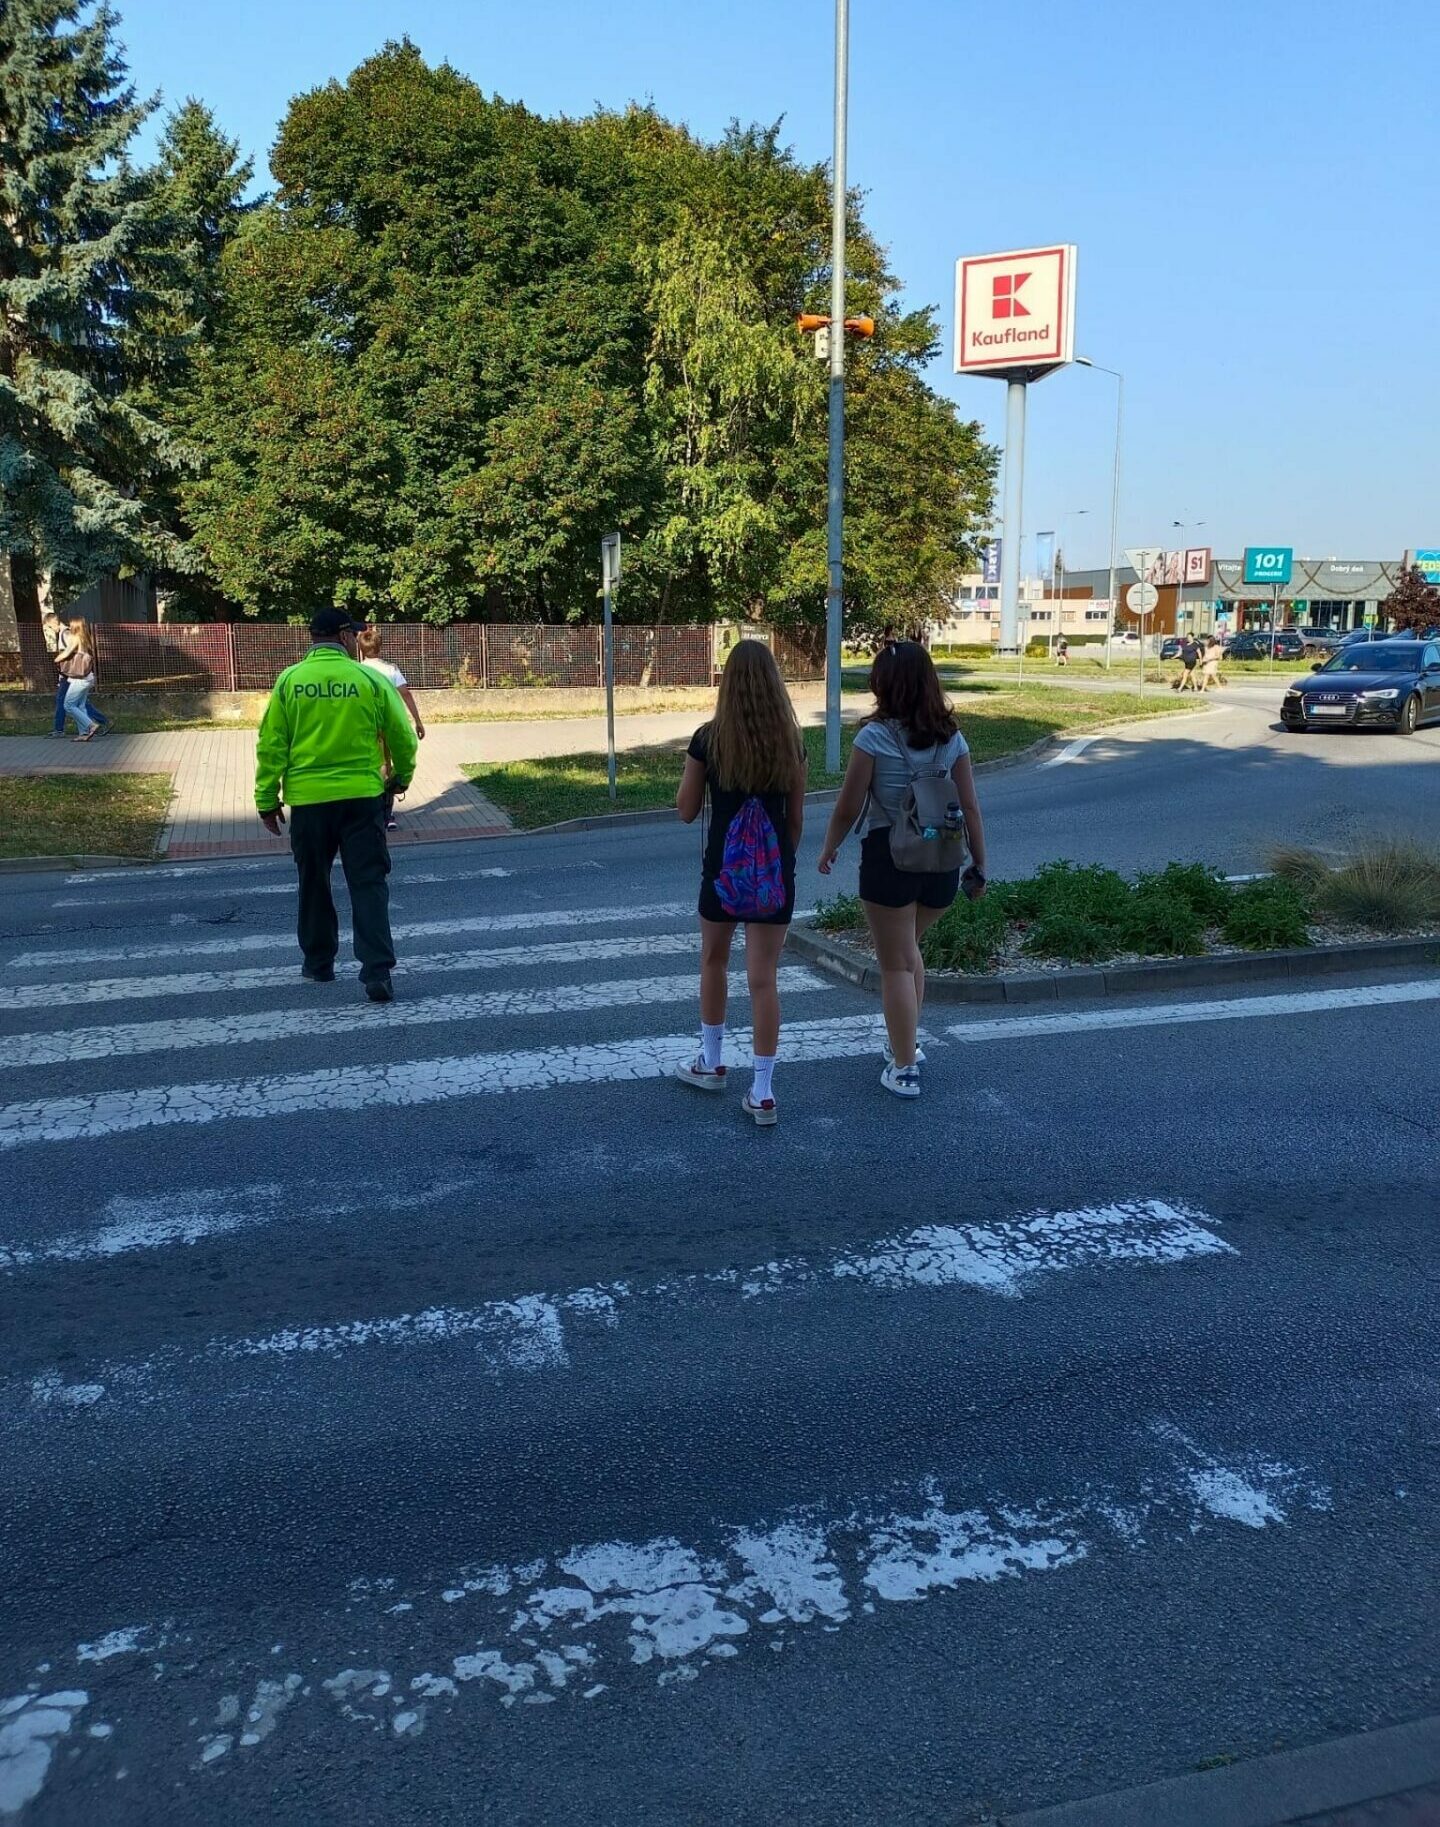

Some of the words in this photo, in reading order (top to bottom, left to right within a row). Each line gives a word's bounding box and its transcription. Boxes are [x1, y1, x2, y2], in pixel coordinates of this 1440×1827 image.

[972, 324, 1049, 347] Kaufland
[1191, 556, 1202, 570] S1
[1218, 563, 1241, 573] Vitajte
[1255, 553, 1285, 569] 101
[1330, 564, 1349, 574] Dobrý
[294, 680, 360, 698] POLÍCIA
